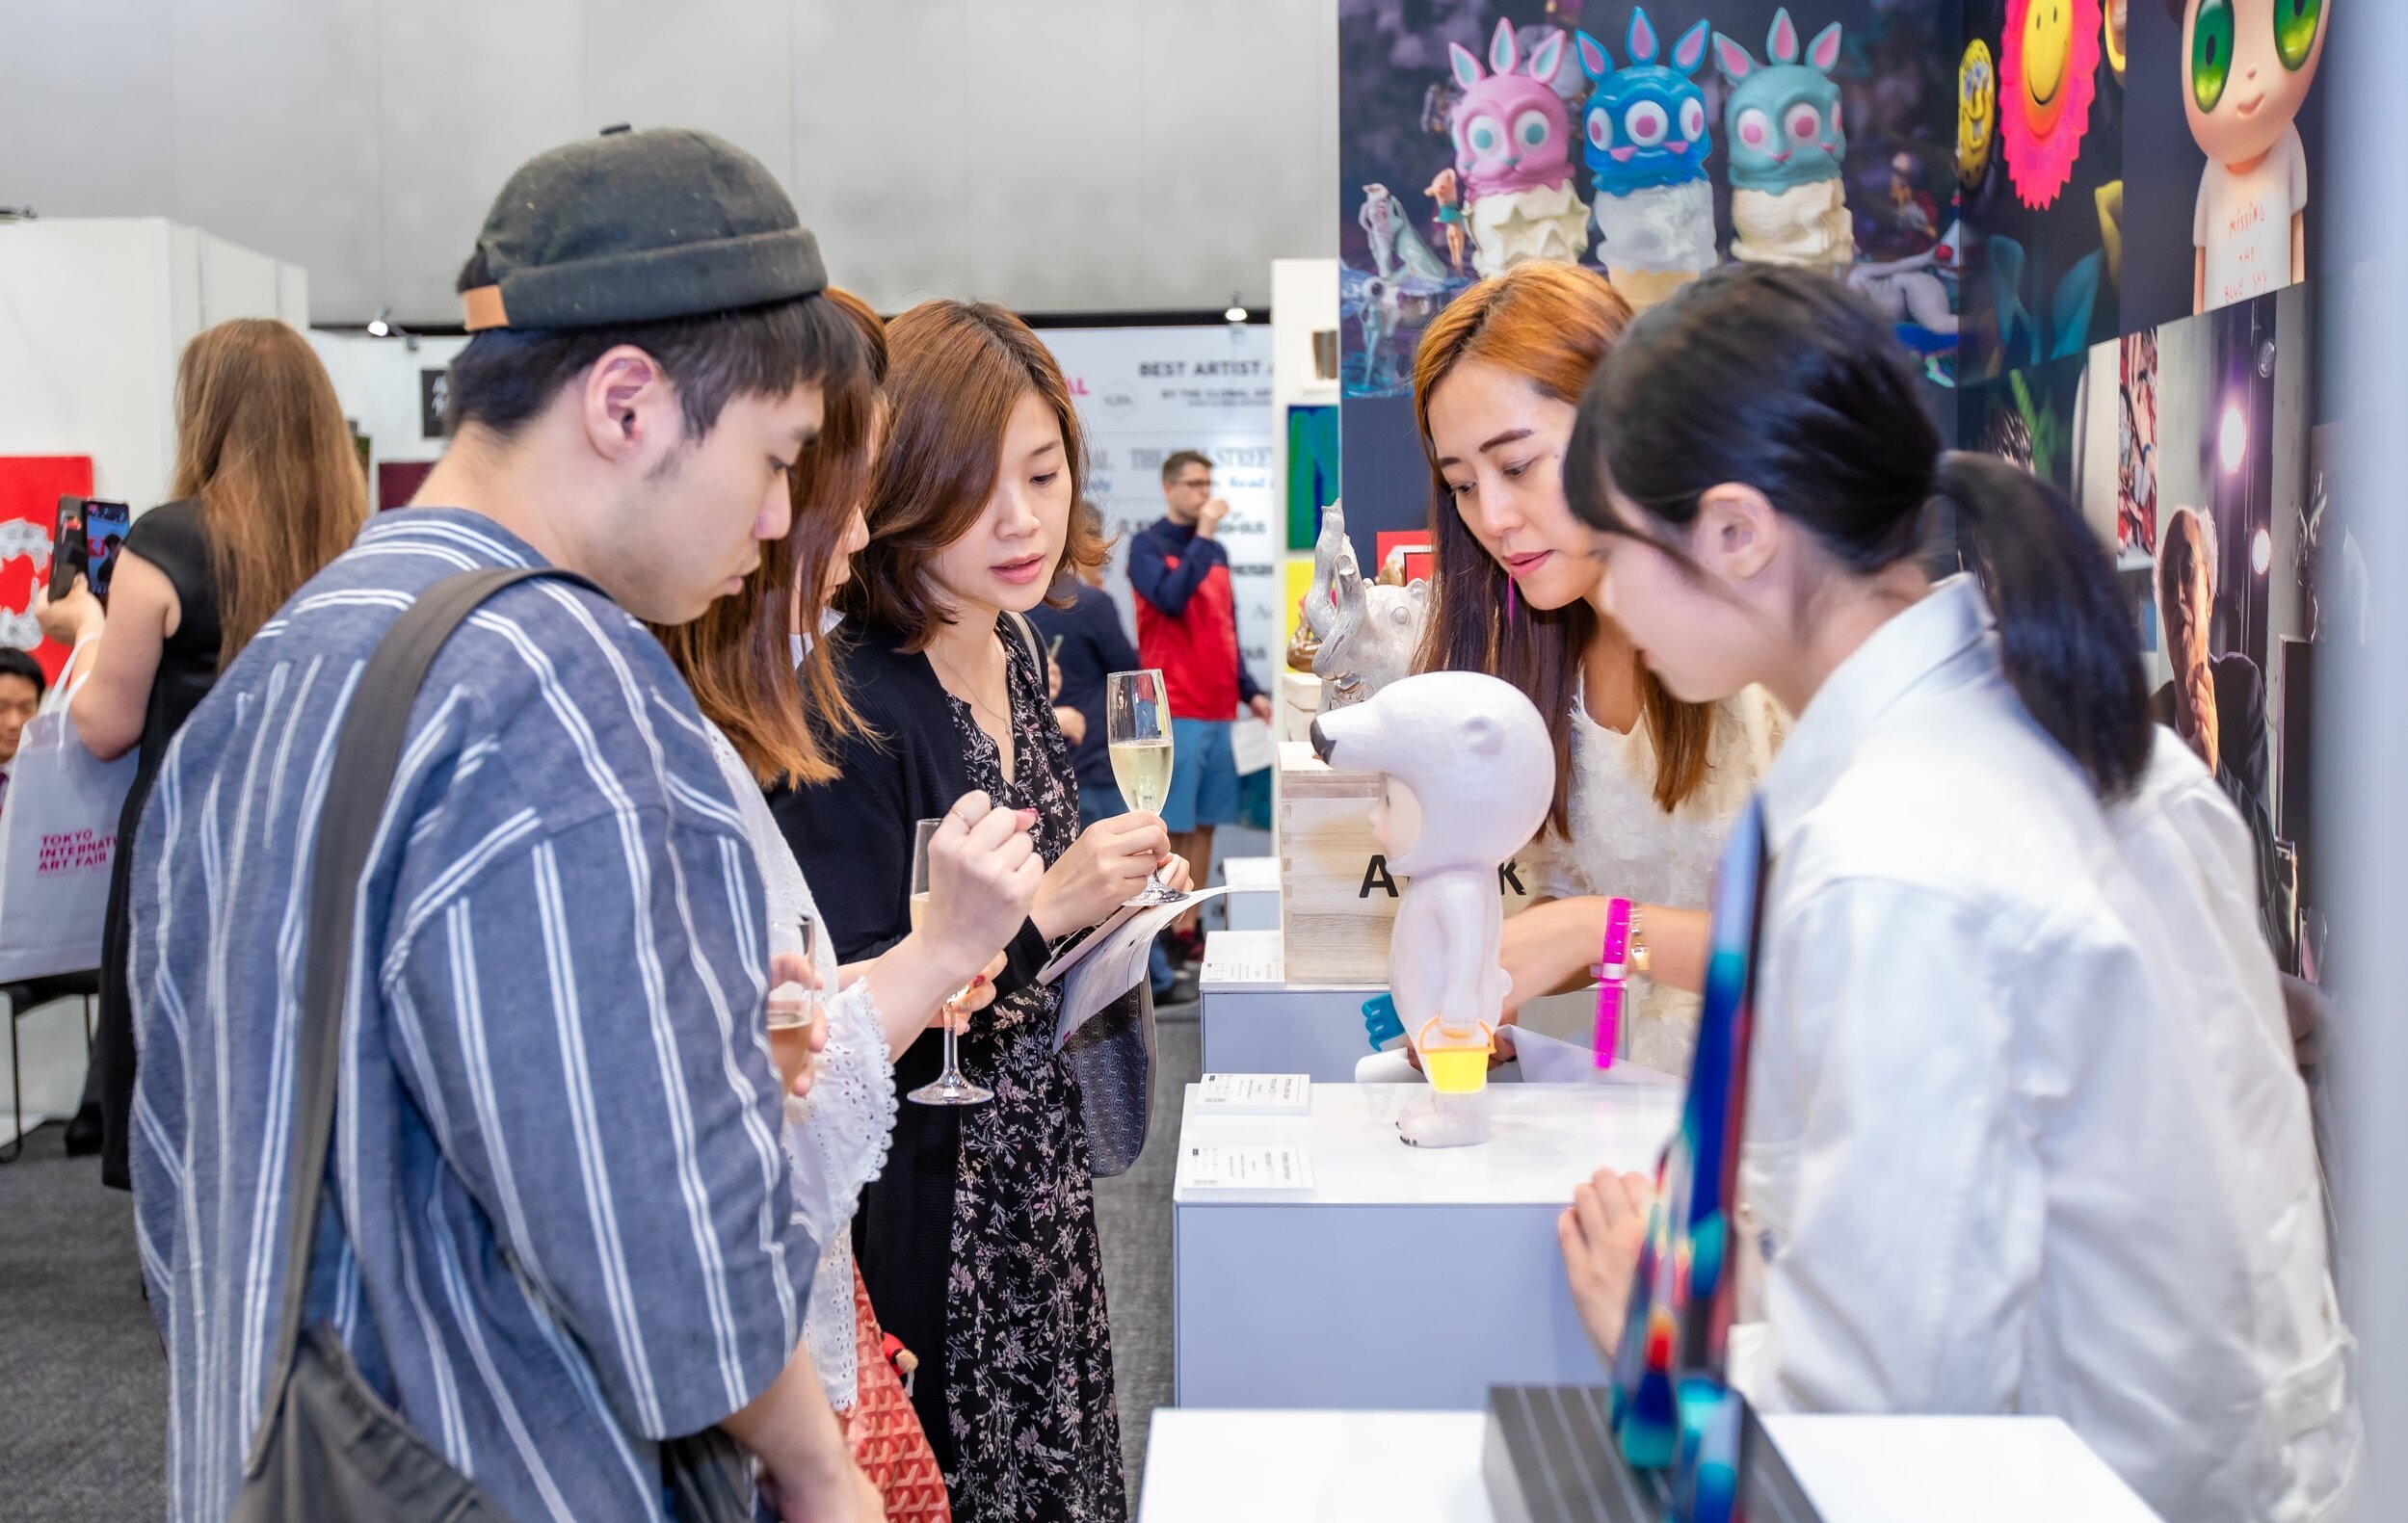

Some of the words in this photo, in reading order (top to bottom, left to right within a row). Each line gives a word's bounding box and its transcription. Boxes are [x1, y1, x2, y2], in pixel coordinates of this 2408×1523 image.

[1139, 360, 1186, 378] BEST
[1194, 359, 1262, 376] ARTIST
[41, 828, 93, 847] TOKYO
[39, 858, 68, 871] ART
[76, 853, 107, 867] FAIR
